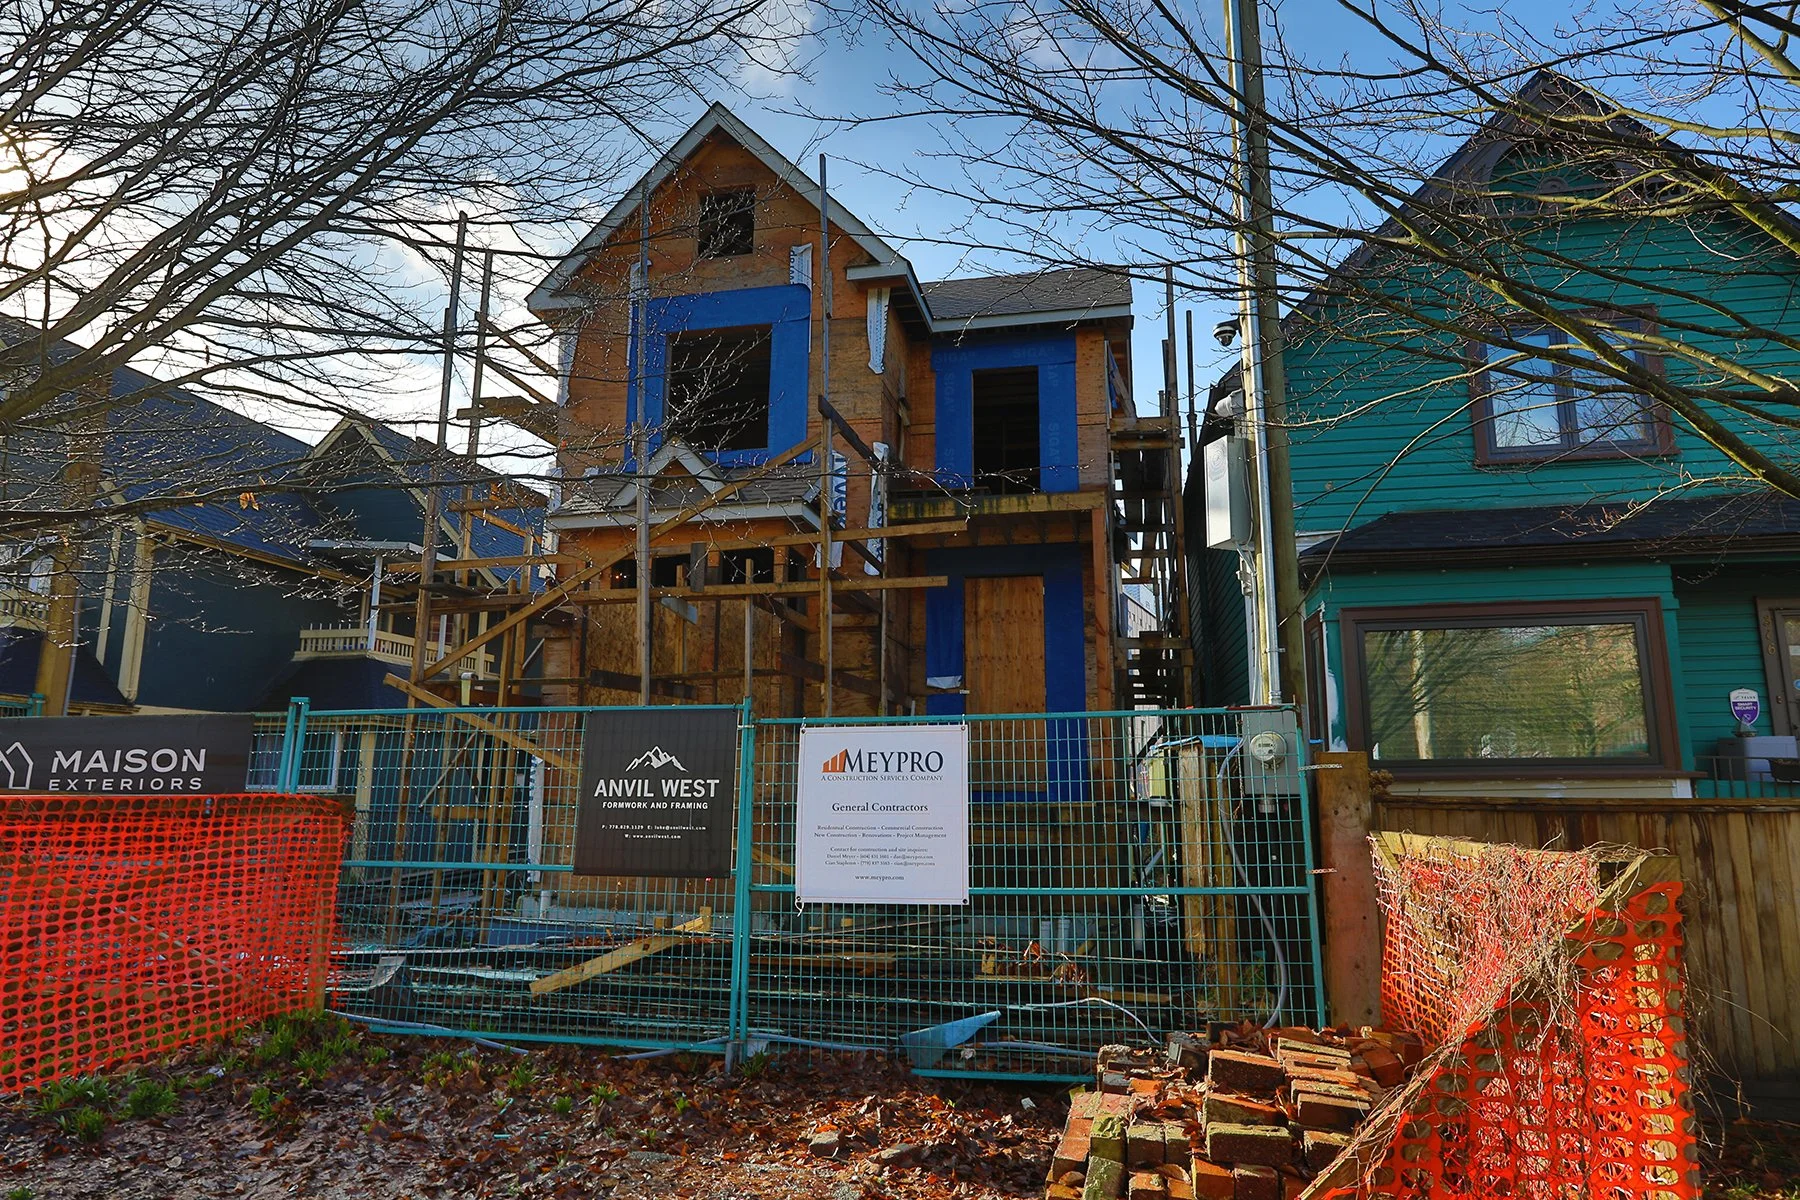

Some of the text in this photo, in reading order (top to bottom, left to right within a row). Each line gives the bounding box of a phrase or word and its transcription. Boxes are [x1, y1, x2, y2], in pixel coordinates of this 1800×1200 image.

[50, 748, 207, 774] MAISON
[843, 748, 944, 773] MEYPRO
[49, 777, 203, 791] EXTERIORS
[594, 779, 720, 798] ANVIL WEST
[670, 802, 709, 810] FRAMING
[832, 802, 929, 812] General Contractors
